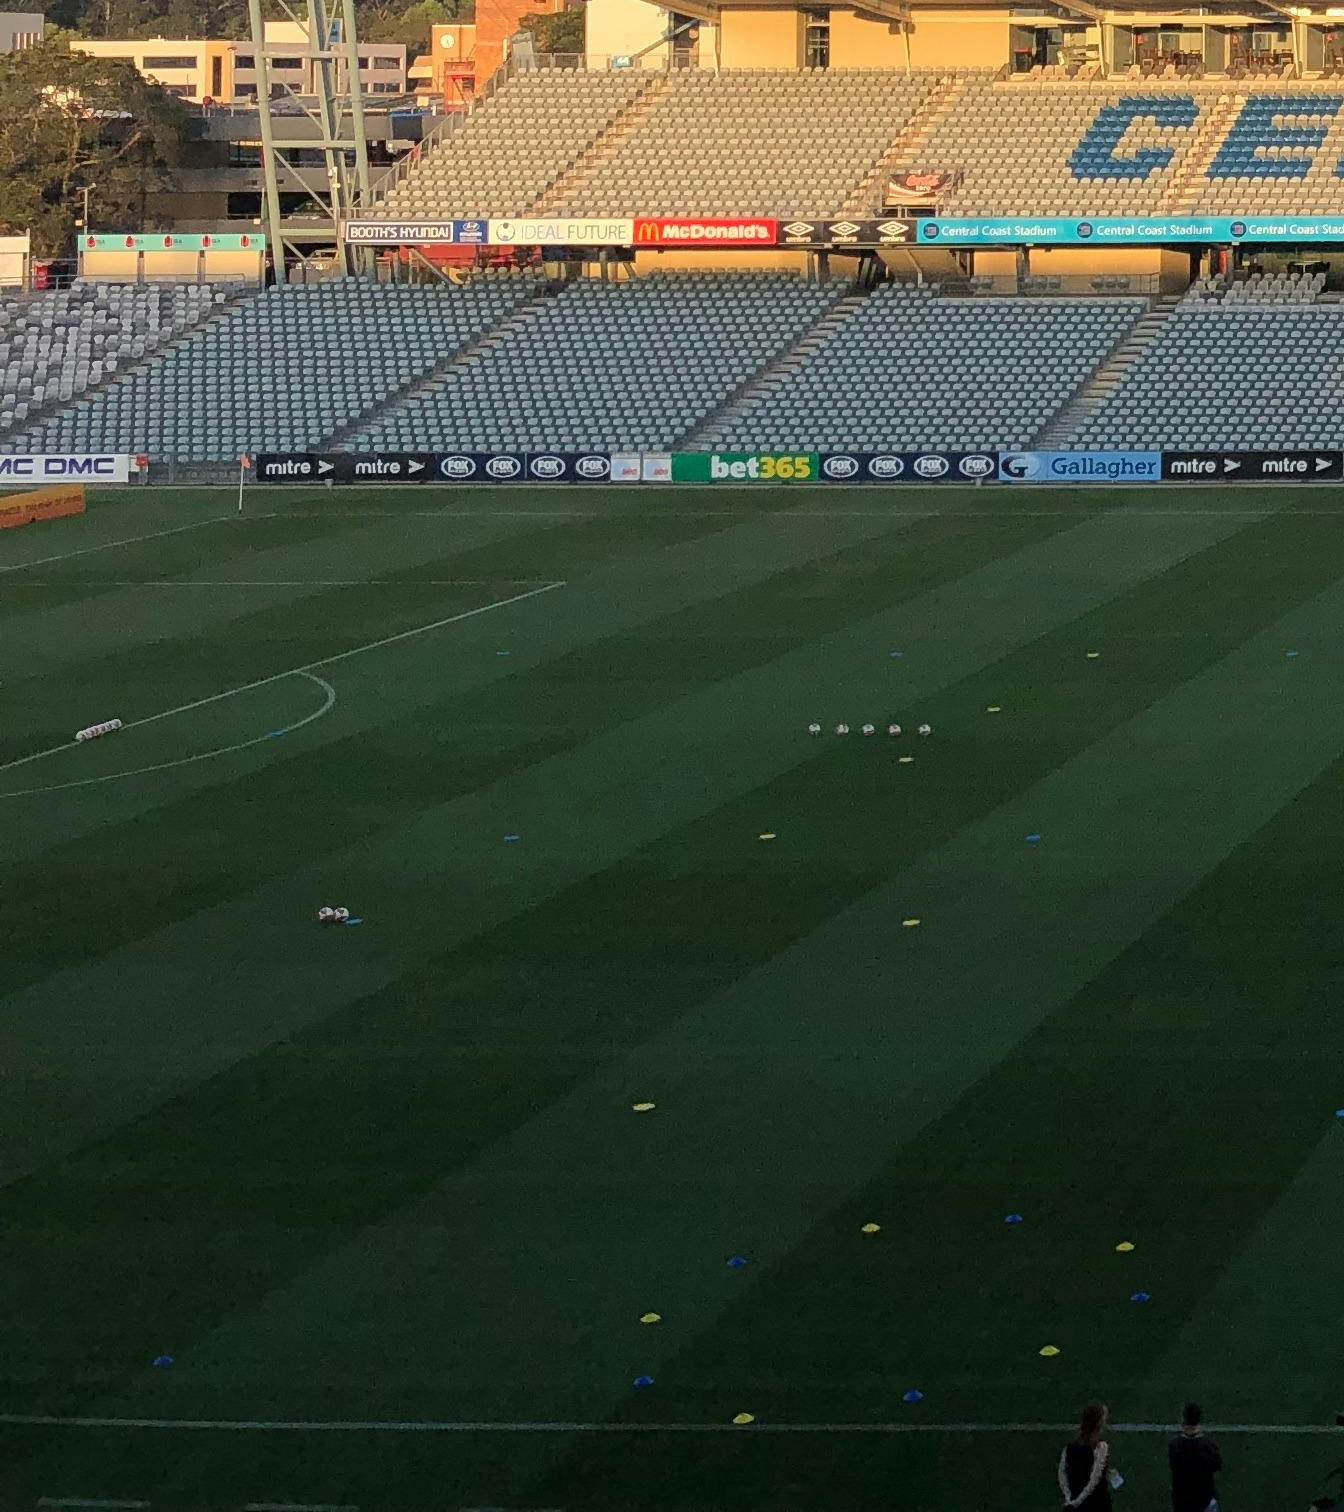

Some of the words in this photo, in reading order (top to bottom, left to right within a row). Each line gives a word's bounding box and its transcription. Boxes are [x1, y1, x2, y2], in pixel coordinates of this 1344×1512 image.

[350, 226, 397, 239] BOOTH'S
[400, 226, 449, 238] HYUNDAI
[521, 223, 563, 240] IDEAL
[568, 223, 626, 240] FUTURE
[662, 224, 768, 239] McDonald's
[941, 226, 978, 236] Central
[982, 226, 1011, 236] Coast
[1014, 226, 1057, 236] Stadium
[1097, 225, 1134, 236] Central
[1138, 225, 1167, 236] Coast
[1170, 224, 1213, 235] Stadium
[1249, 224, 1286, 235] Central
[1289, 224, 1319, 235] Coast
[44, 458, 115, 474] DMC
[266, 461, 311, 476] mitre
[355, 460, 401, 475] mitre
[710, 455, 810, 479] bet365
[1051, 456, 1156, 478] Gallagher
[1170, 459, 1216, 474] mitre
[1262, 458, 1307, 473] mitre
